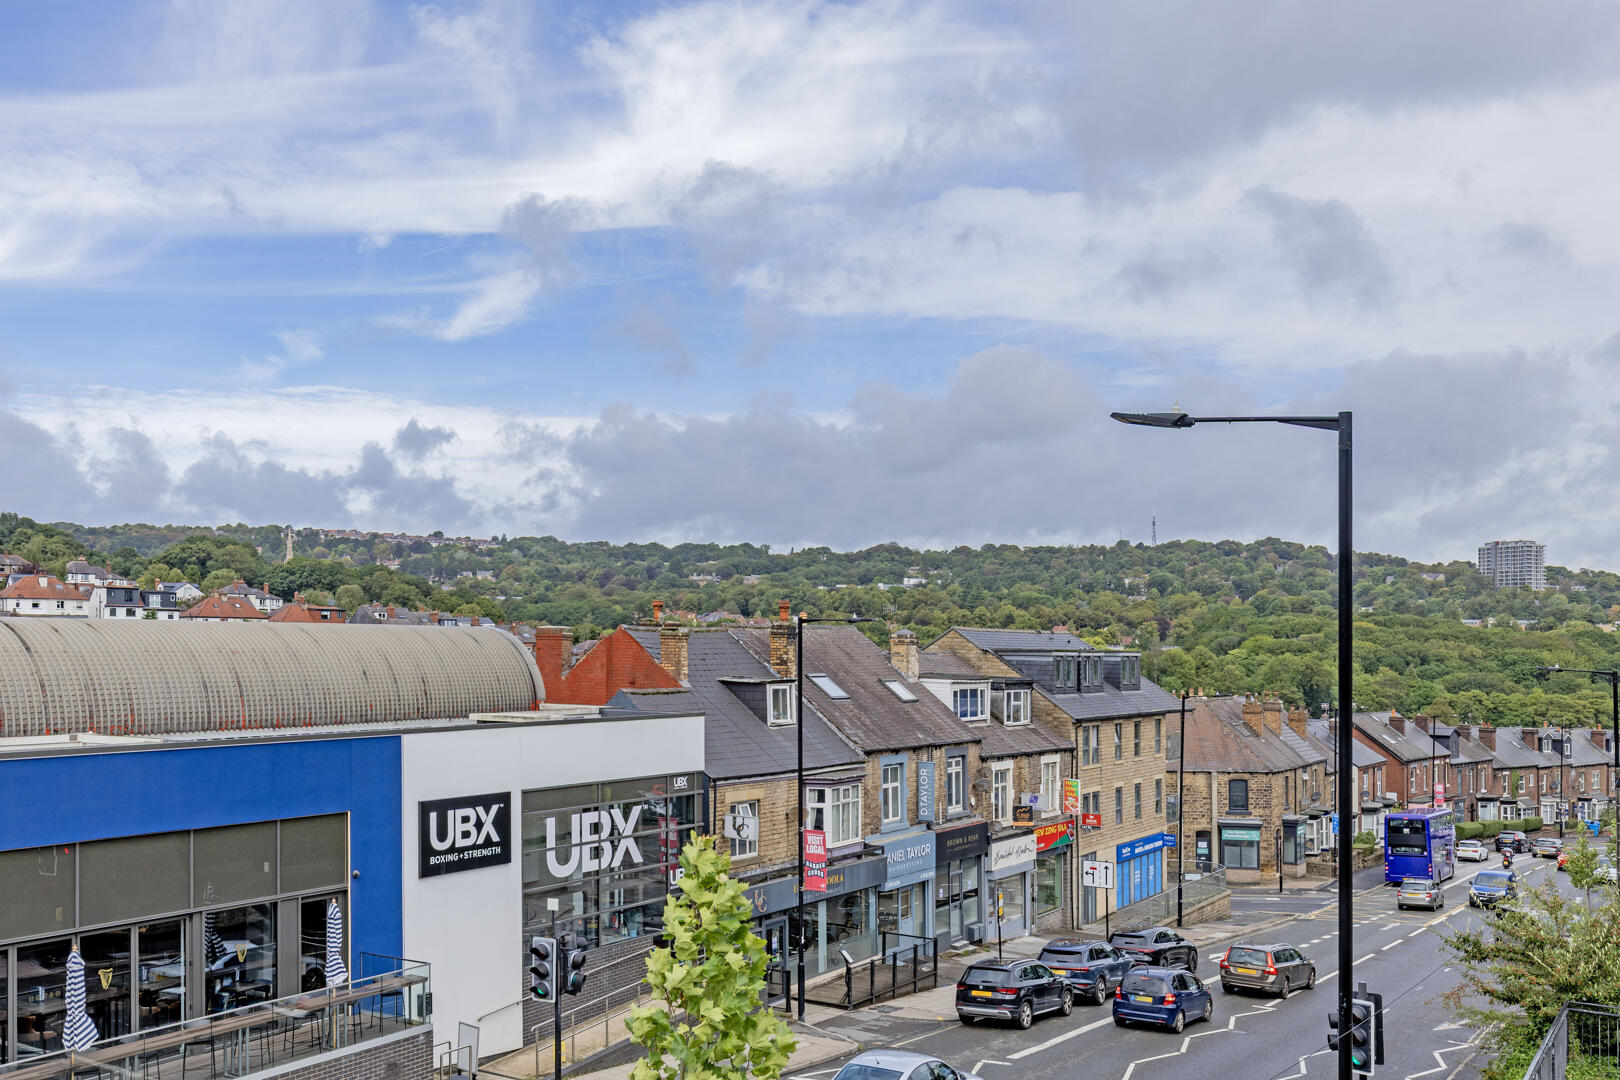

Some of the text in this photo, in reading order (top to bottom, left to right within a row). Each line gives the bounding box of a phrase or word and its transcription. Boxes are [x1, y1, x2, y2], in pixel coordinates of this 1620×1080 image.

[430, 804, 500, 851] UBX
[546, 805, 644, 878] UBX
[806, 845, 826, 855] LOCAL
[807, 835, 824, 846] VISIT
[886, 850, 905, 865] ANIEL
[906, 843, 931, 859] TAYLOR
